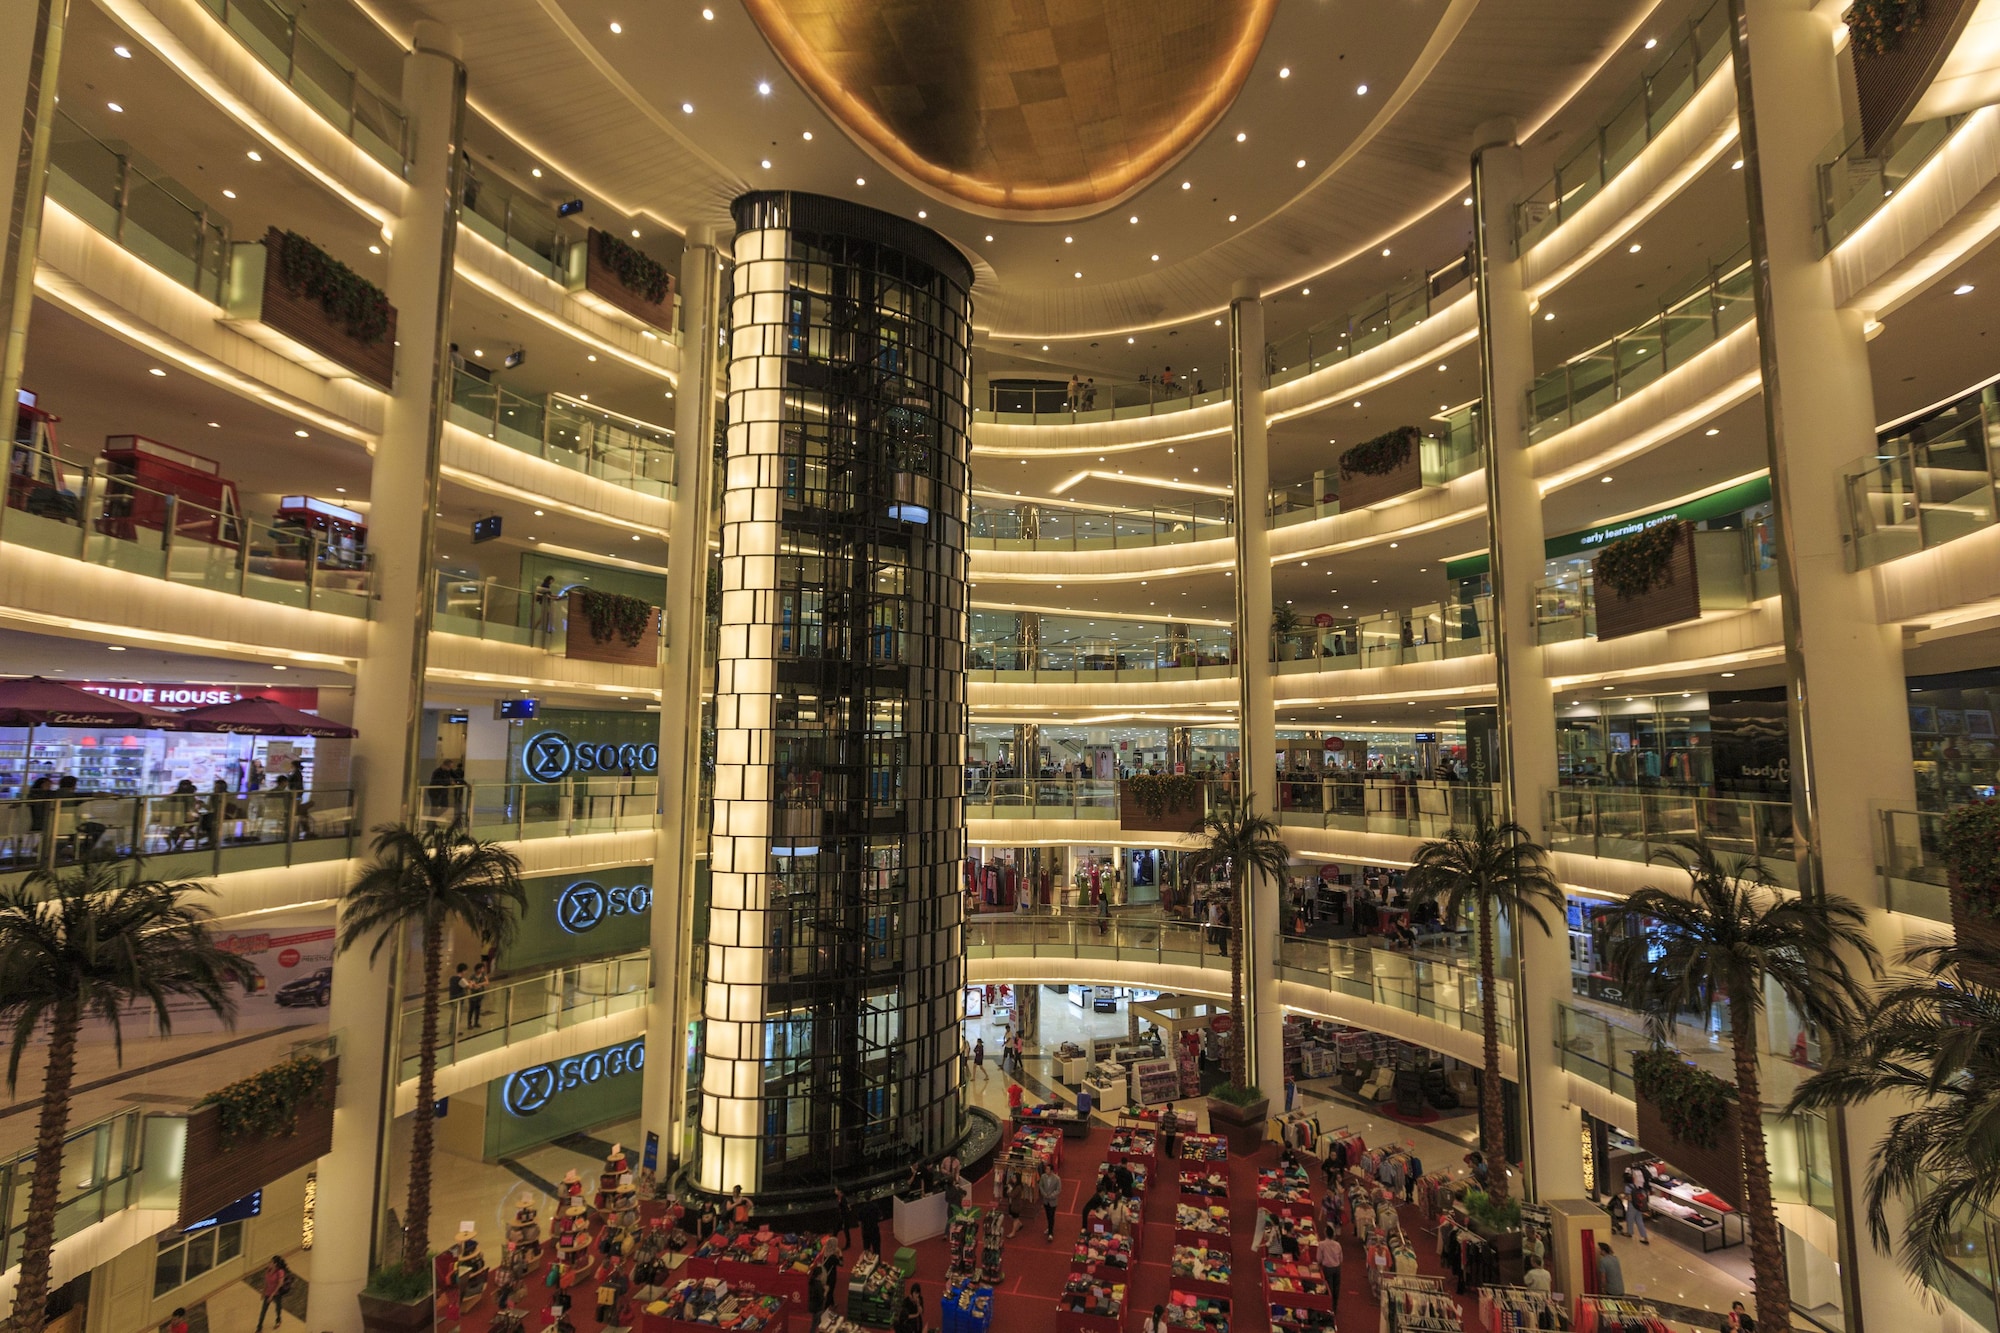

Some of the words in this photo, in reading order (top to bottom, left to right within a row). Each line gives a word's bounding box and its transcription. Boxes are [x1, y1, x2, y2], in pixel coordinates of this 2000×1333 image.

[1581, 531, 1604, 544] early
[1605, 522, 1644, 539] learning
[1645, 513, 1678, 529] centre
[82, 687, 156, 702] TUDE
[160, 690, 231, 704] HOUSE
[54, 714, 114, 724] Chatime
[574, 741, 658, 772] SOGO
[557, 1041, 645, 1092] SOGO
